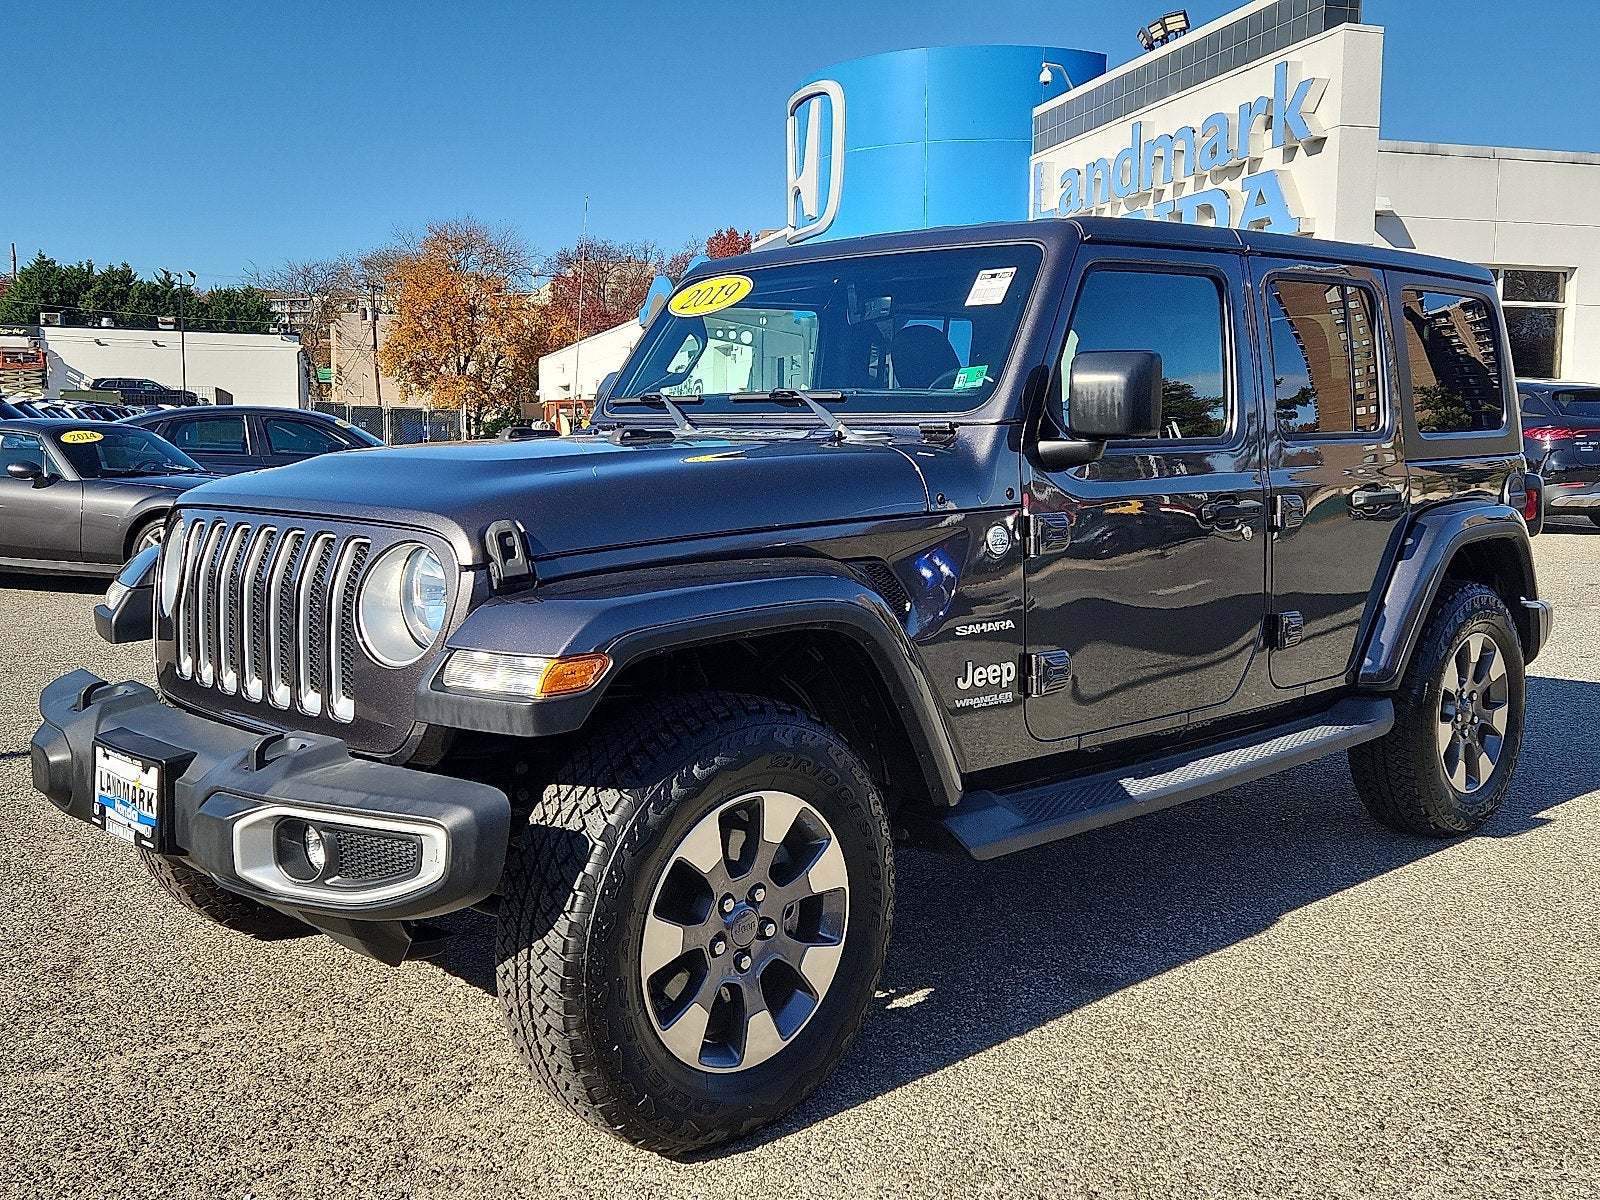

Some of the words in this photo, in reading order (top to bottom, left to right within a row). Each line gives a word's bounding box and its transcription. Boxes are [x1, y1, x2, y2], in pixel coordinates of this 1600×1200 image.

[1034, 61, 1314, 219] Landmark
[678, 281, 741, 310] 2019
[69, 432, 98, 442] 2014
[955, 619, 1016, 636] SAHARA
[956, 659, 1016, 690] Jeep
[954, 691, 1013, 708] WRANGLER
[973, 698, 1013, 709] UNLIMITED
[99, 770, 156, 815] LANDMARK
[115, 798, 139, 820] Honda
[766, 753, 884, 932] BRIDGESTONE
[734, 920, 757, 935] Jeep
